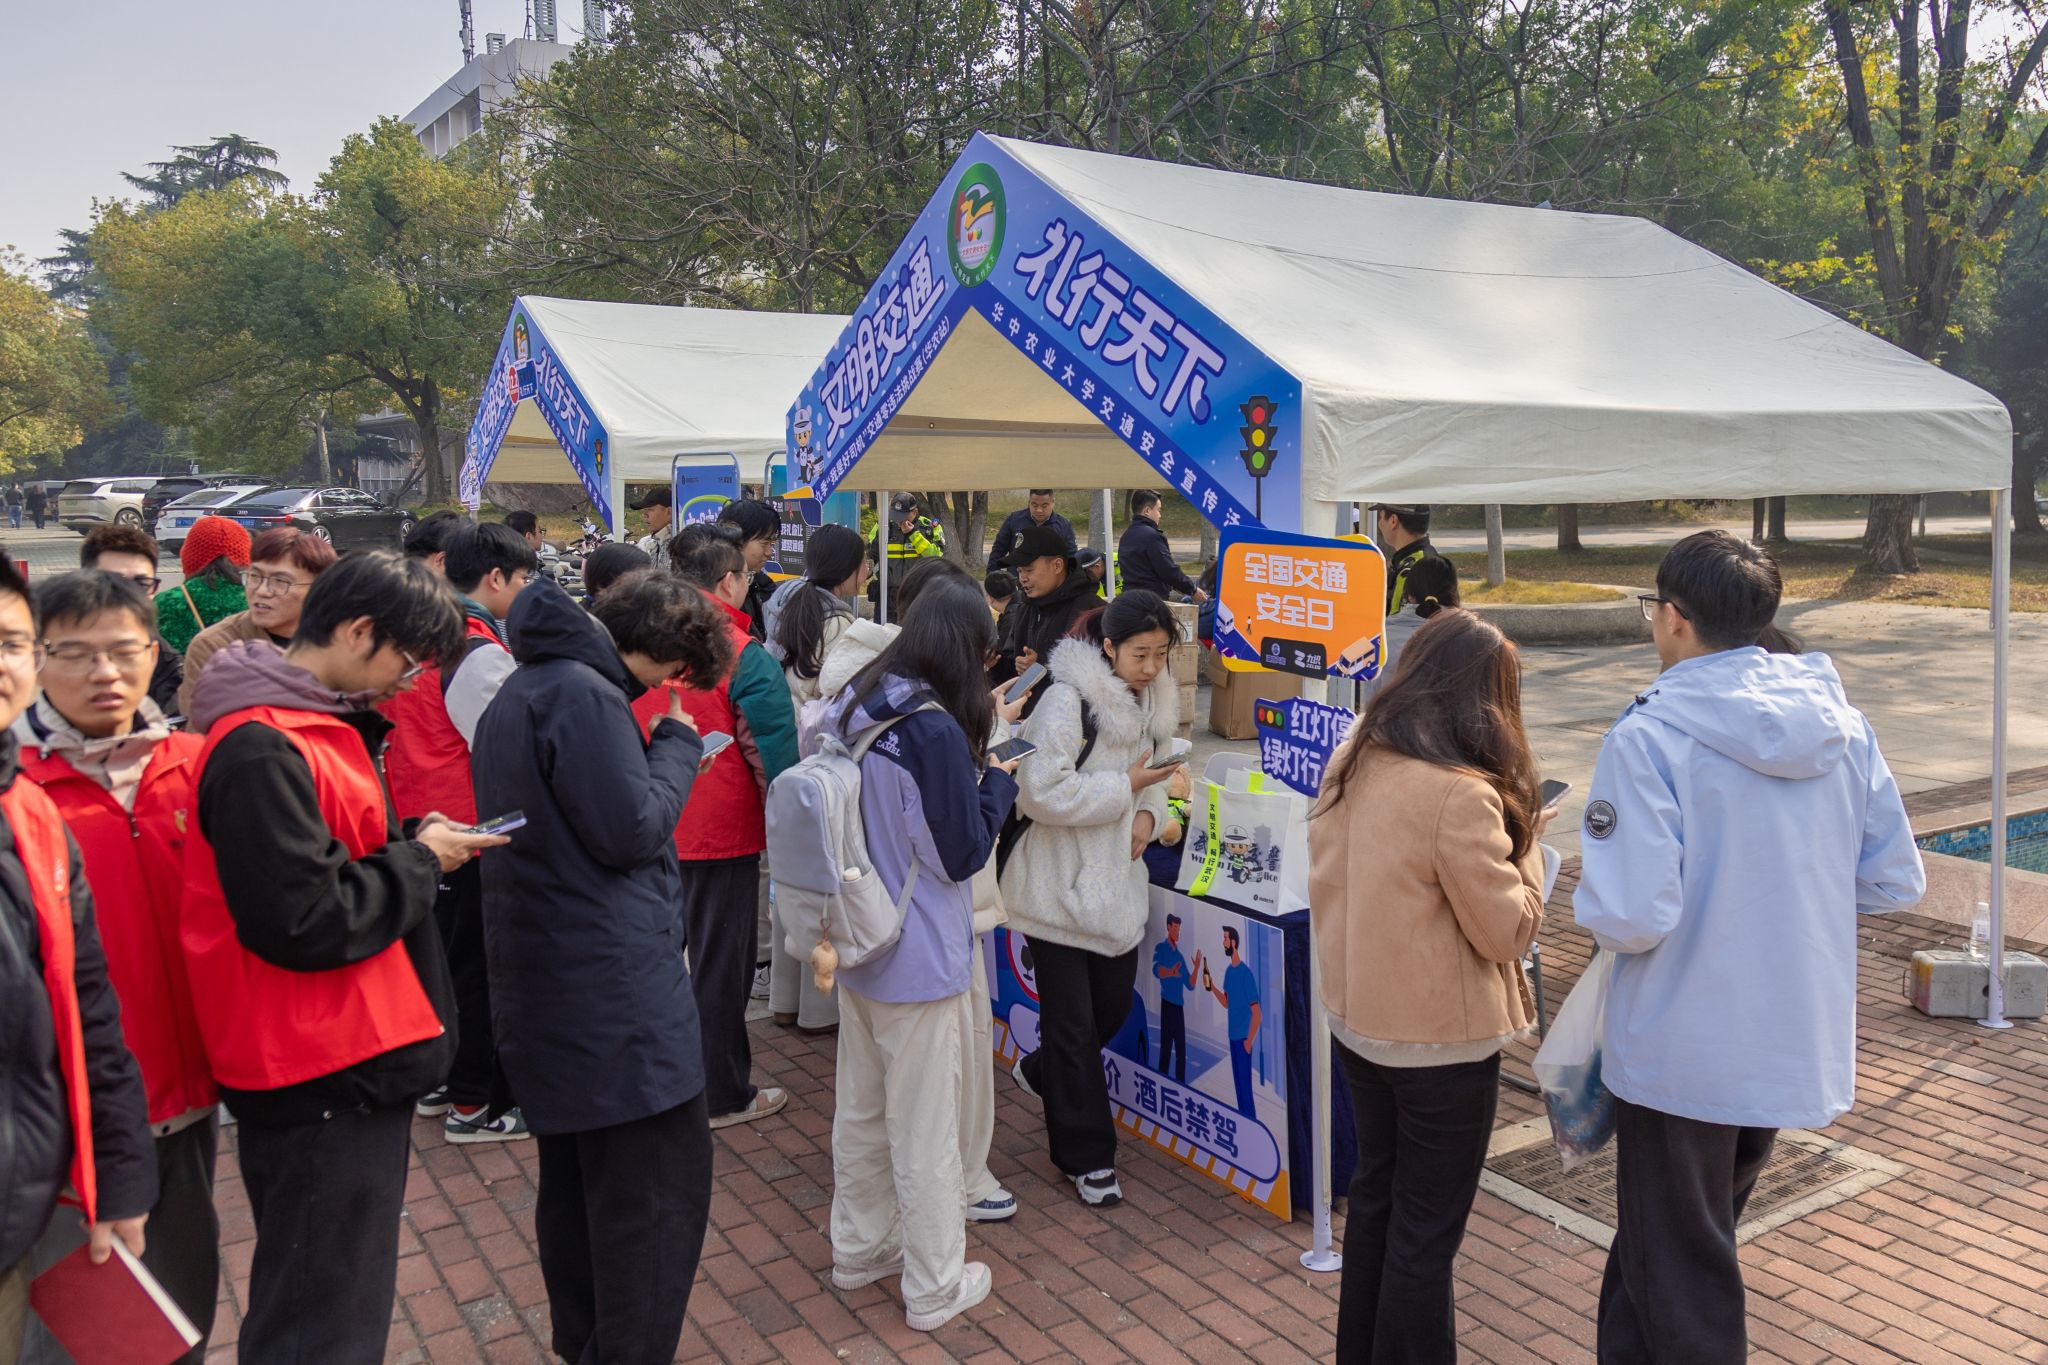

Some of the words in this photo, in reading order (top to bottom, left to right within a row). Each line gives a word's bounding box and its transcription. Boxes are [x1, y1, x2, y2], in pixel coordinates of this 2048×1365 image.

[820, 236, 946, 452] 文明交通
[1014, 217, 1227, 424] 礼行天下
[535, 345, 590, 452] 礼行天下
[1244, 552, 1348, 593] 全国交通
[1256, 592, 1334, 631] 安全日
[875, 739, 902, 757] CAMEL
[1263, 736, 1321, 788] 绿灯行
[1591, 812, 1610, 823] Jeep
[1134, 1070, 1239, 1158] 酒后禁驾
